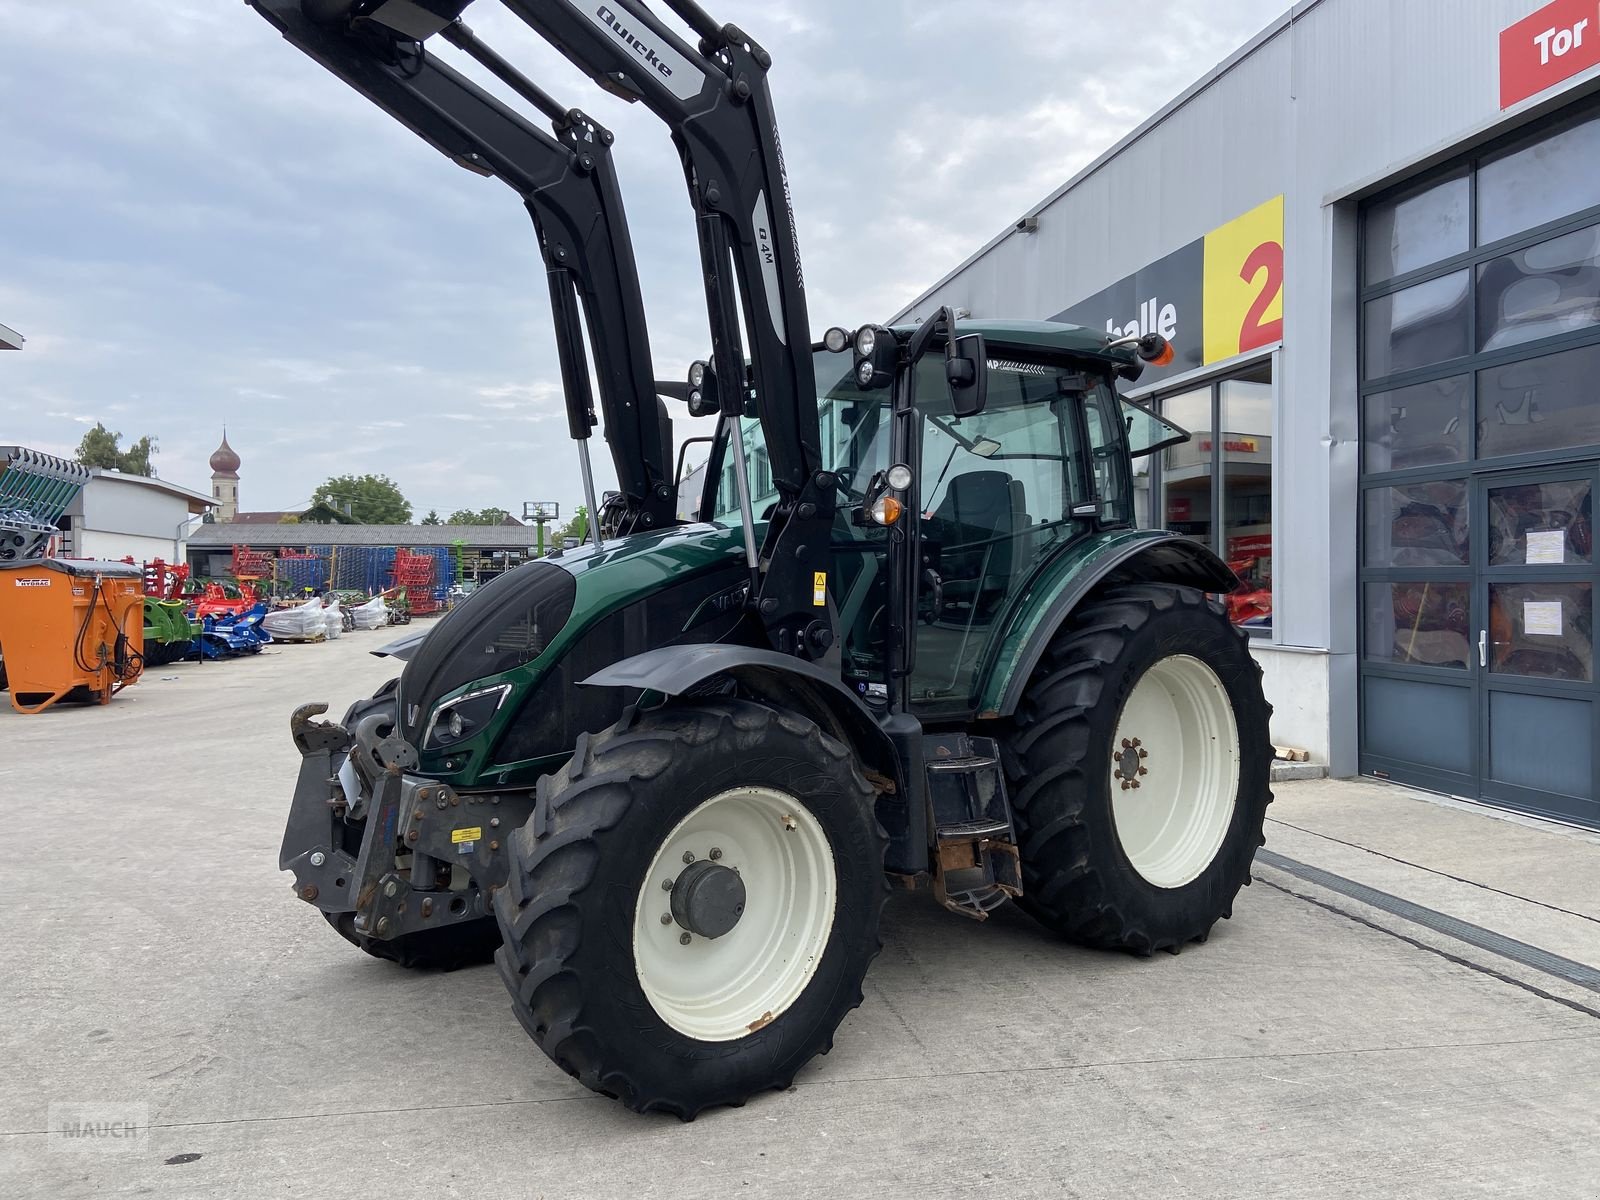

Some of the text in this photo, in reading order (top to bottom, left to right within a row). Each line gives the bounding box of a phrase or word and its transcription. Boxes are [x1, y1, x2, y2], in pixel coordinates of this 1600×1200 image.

[597, 6, 673, 78] Quicke
[1534, 18, 1588, 65] Tor
[1238, 241, 1283, 354] 2
